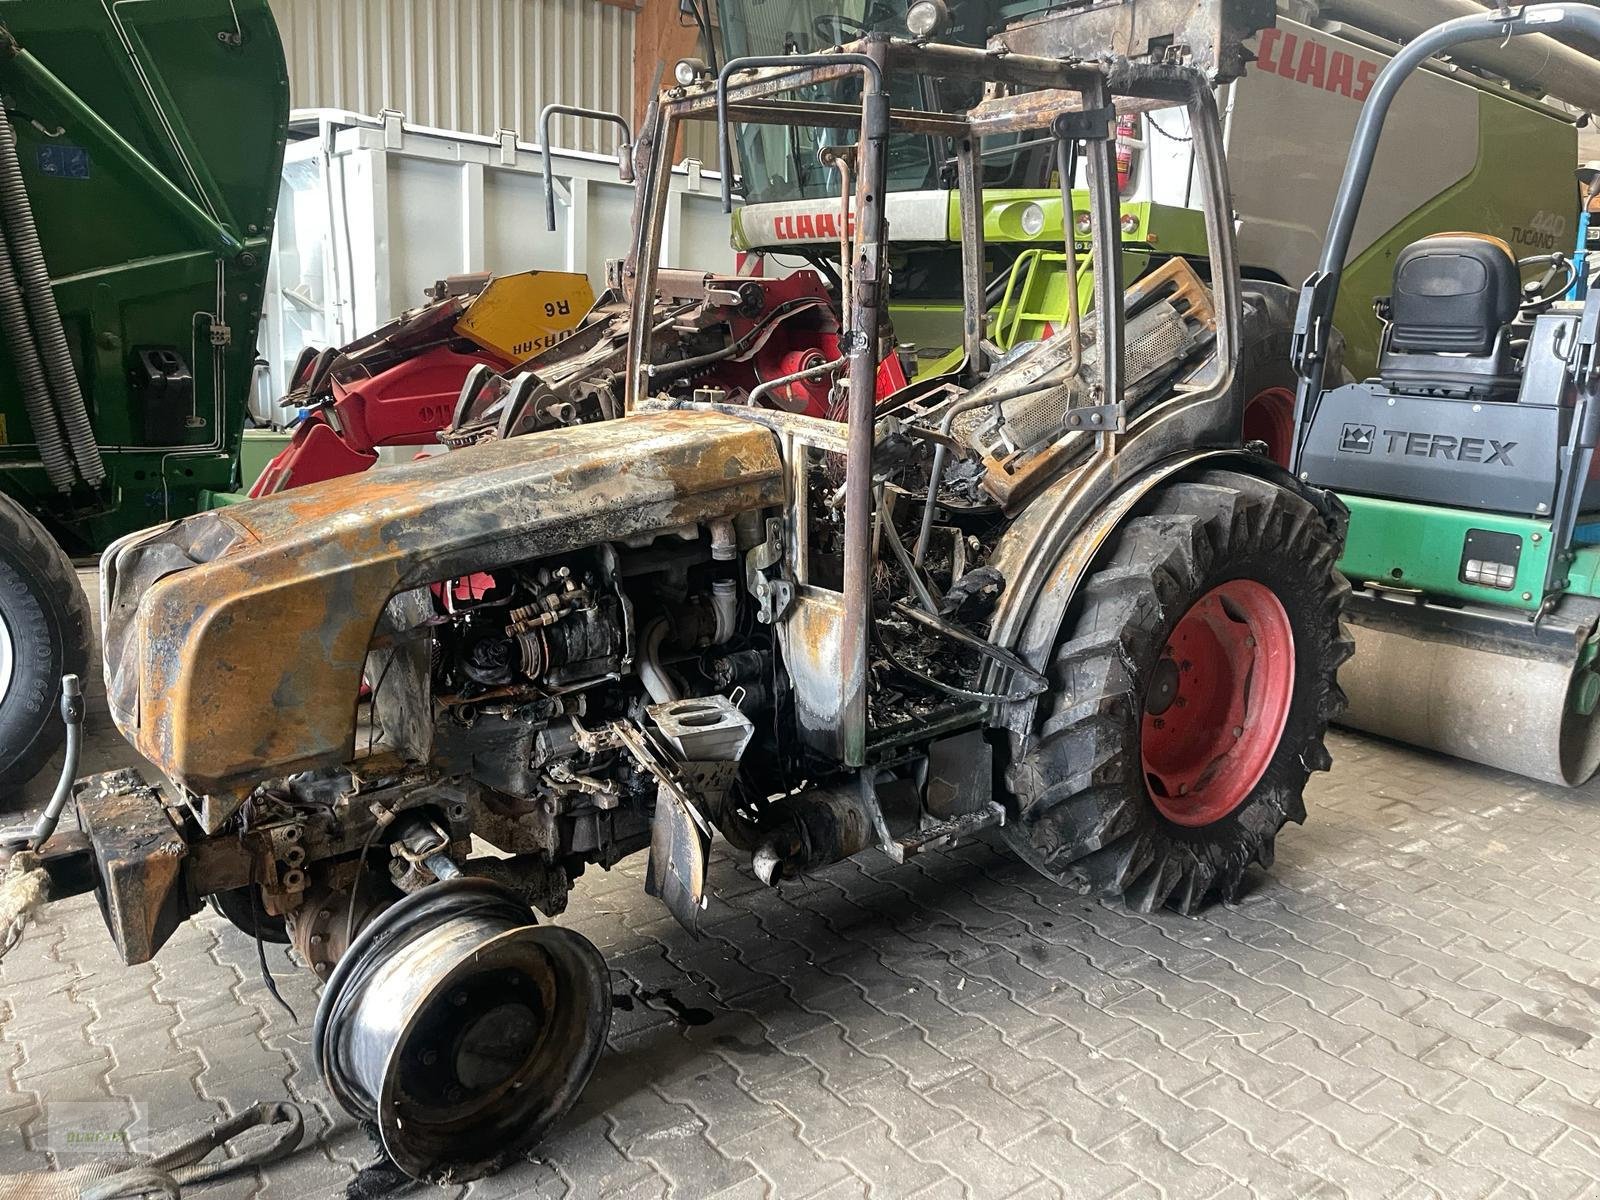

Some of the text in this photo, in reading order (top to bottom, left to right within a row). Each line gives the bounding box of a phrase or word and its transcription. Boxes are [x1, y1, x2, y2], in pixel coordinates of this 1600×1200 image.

[1256, 28, 1377, 103] CLAAS
[1512, 226, 1555, 250] TUCANO
[544, 299, 570, 318] R6
[513, 328, 574, 355] UASAR
[1382, 429, 1520, 467] TEREX
